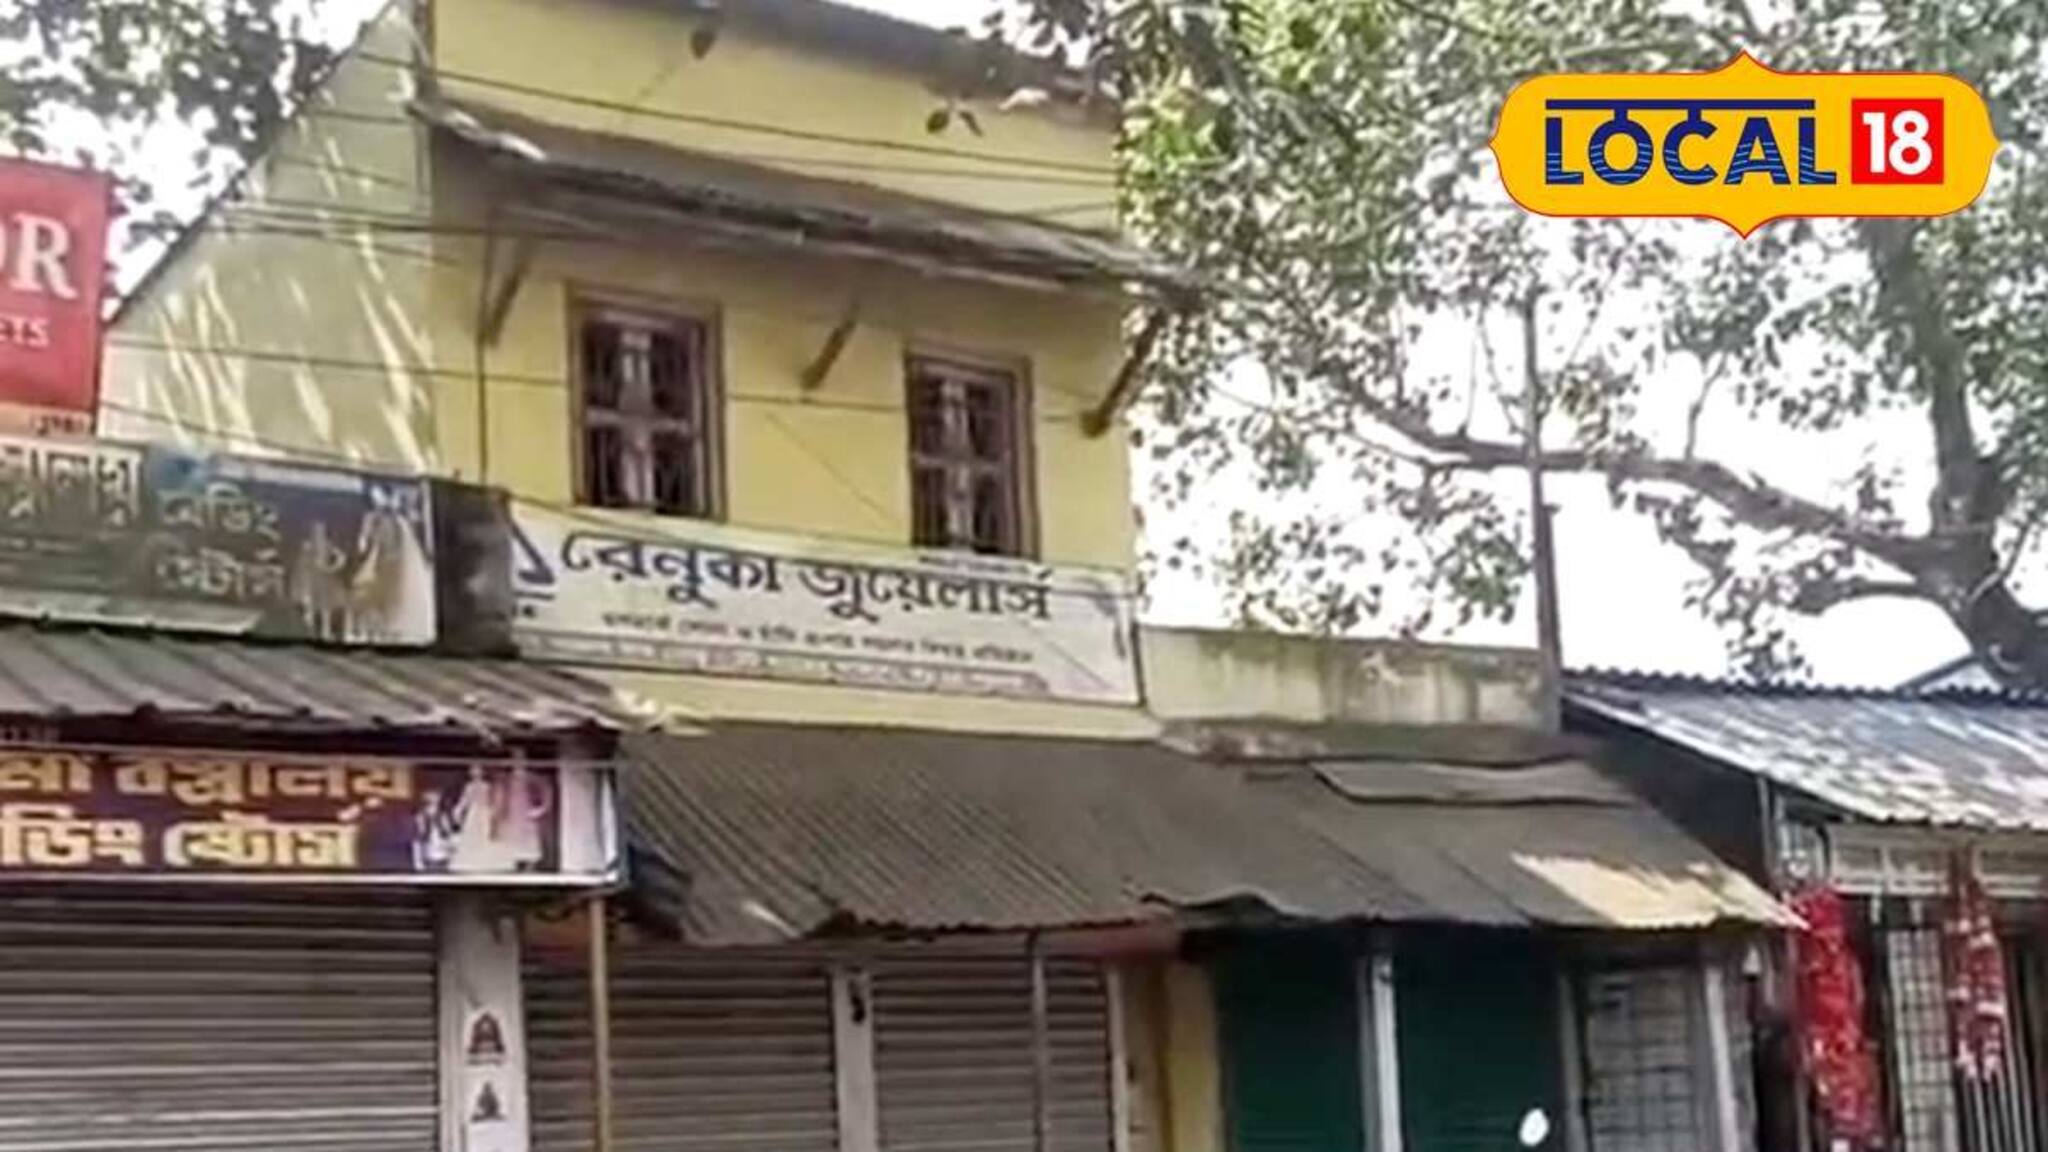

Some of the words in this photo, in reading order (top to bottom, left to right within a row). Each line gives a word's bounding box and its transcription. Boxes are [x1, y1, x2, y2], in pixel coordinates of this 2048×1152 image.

[0, 211, 79, 299] R
[561, 530, 783, 609] রেনুকা
[796, 559, 1053, 624] জুয়েলার্স
